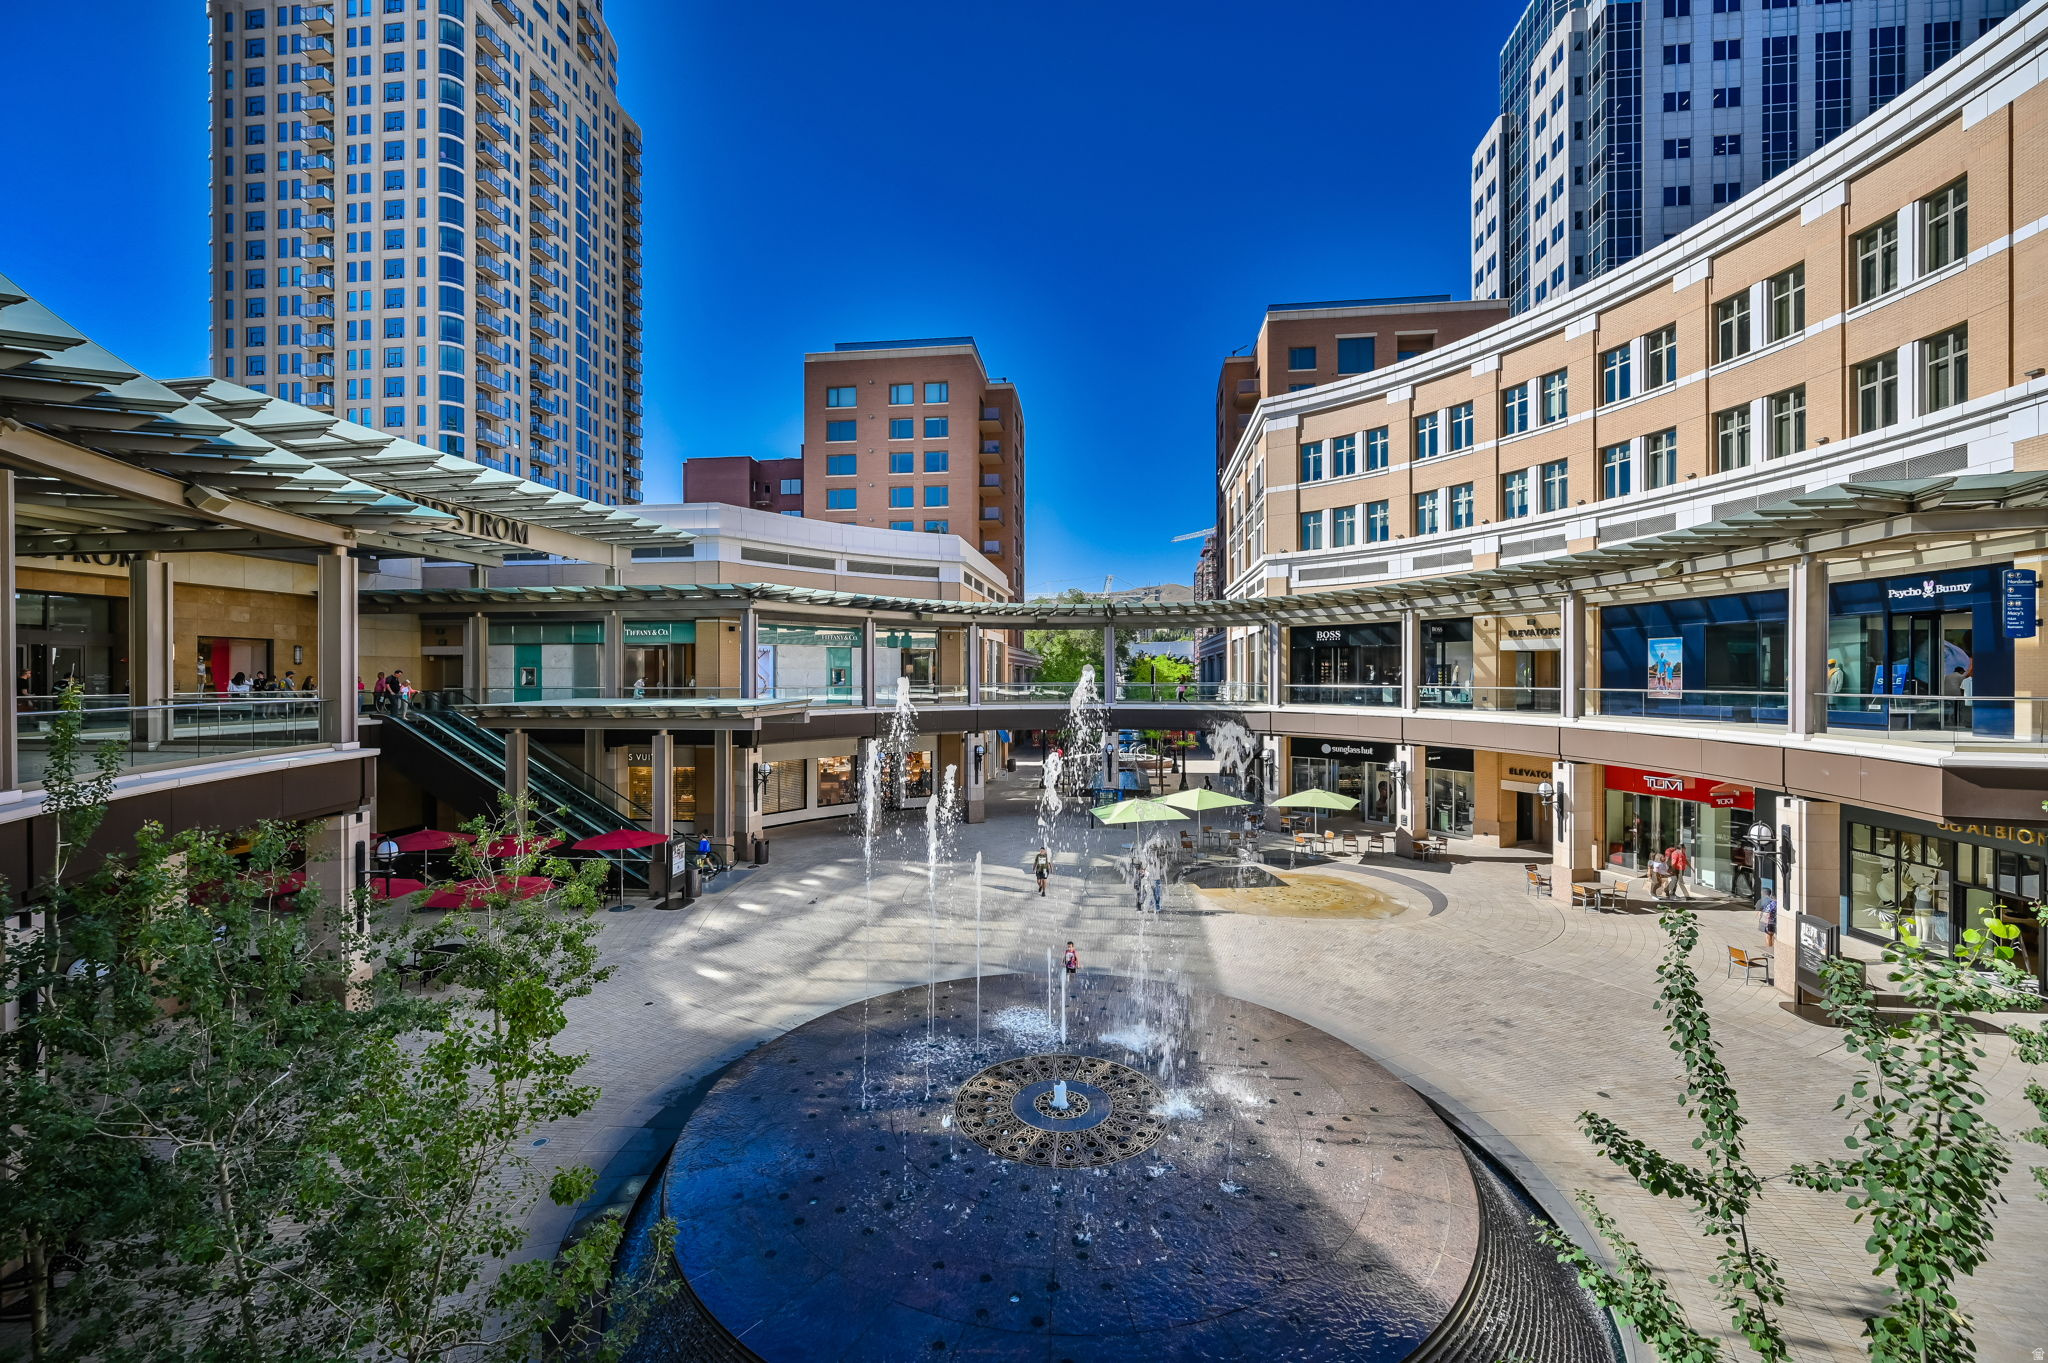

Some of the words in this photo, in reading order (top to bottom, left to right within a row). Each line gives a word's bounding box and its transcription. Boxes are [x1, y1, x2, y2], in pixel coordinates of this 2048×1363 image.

[394, 490, 529, 545] STROM
[1888, 587, 1922, 599] Psycho
[1935, 583, 1972, 593] Bunny
[1316, 630, 1341, 639] BOSS
[1508, 628, 1561, 638] ELEVATORS
[1876, 677, 1903, 685] SE
[1419, 687, 1441, 695] ALE
[1331, 745, 1361, 755] sunglass
[1361, 746, 1374, 755] hut
[635, 753, 654, 761] VUI
[1643, 775, 1683, 792] TUMI
